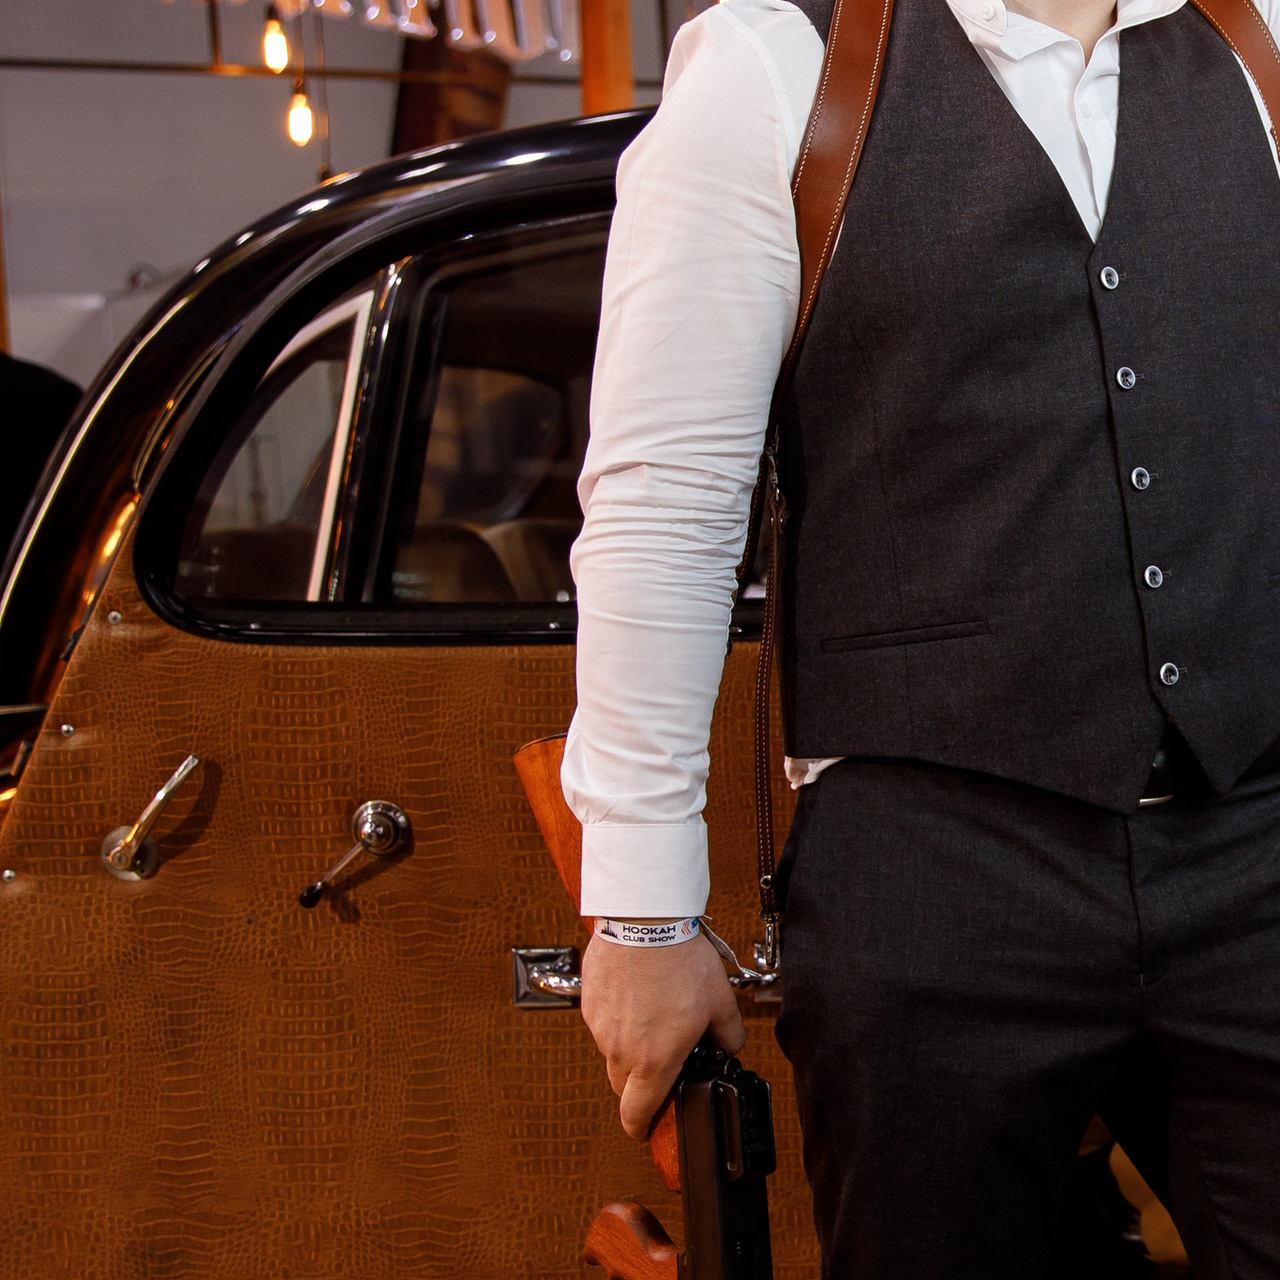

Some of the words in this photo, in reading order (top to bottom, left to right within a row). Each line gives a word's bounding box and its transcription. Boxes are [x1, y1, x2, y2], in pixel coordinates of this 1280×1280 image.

[622, 924, 676, 935] HOOKAH
[622, 934, 646, 943] CLUB
[648, 934, 676, 943] SHOW
